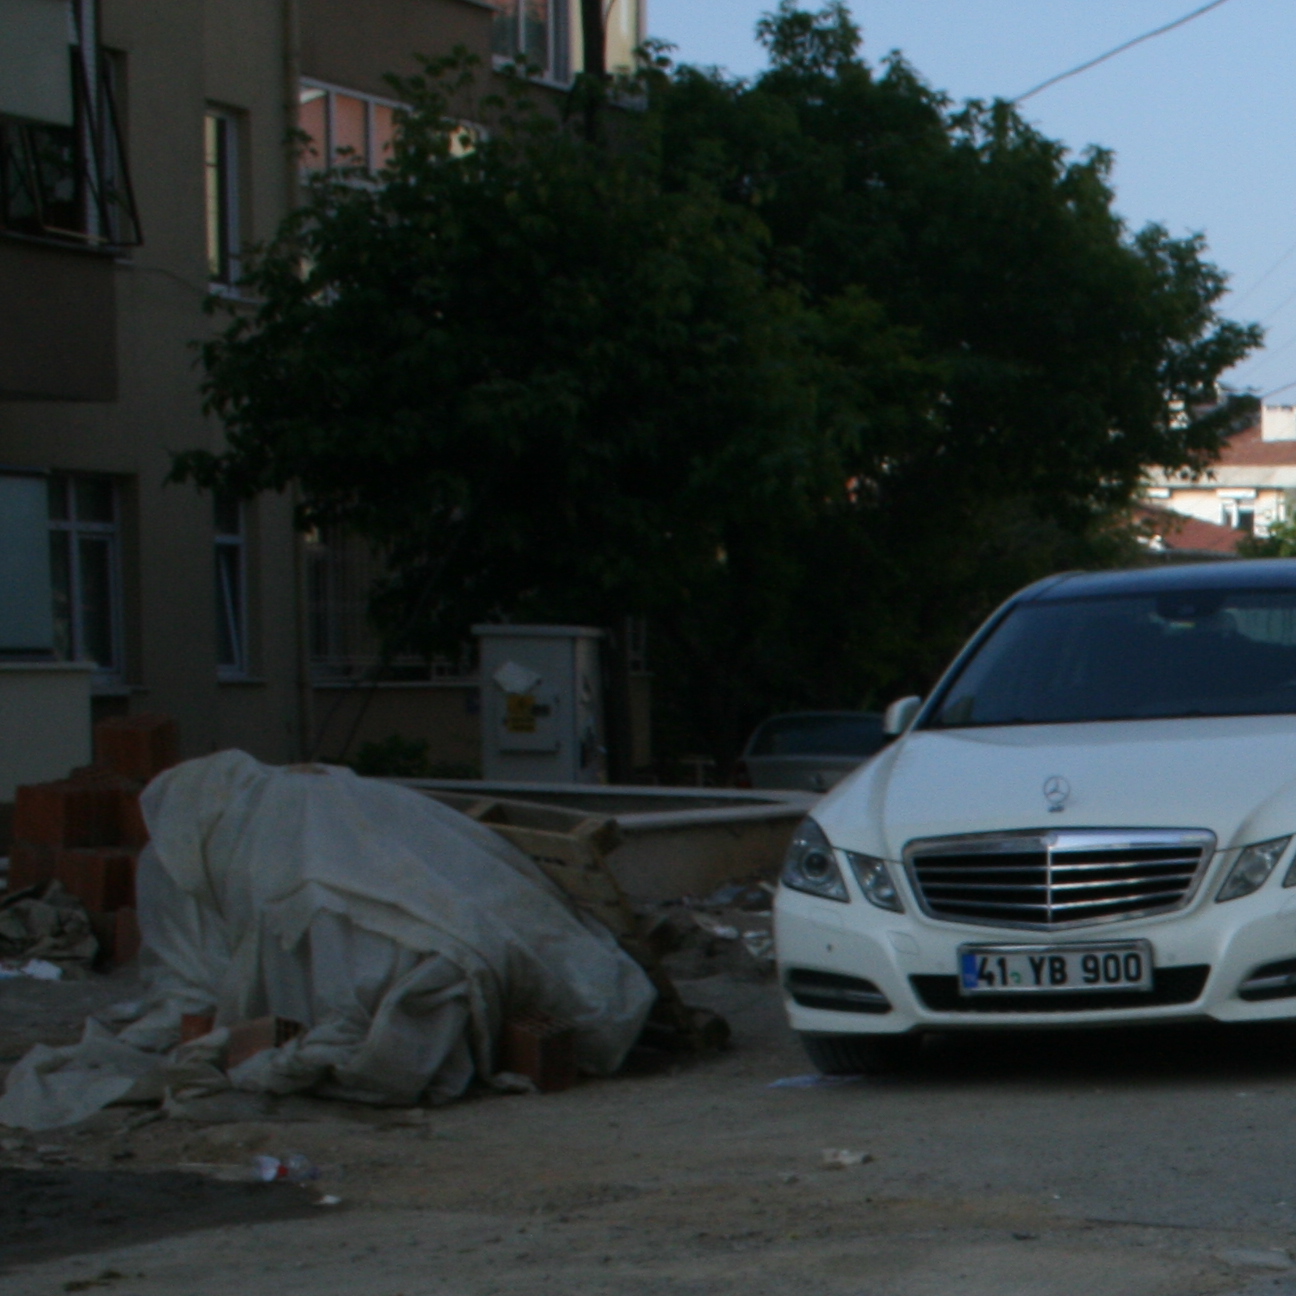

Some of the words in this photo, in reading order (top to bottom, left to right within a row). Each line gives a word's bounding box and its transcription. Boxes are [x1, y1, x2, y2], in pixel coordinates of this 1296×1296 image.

[977, 956, 1009, 986] 41
[1029, 955, 1068, 985] YB
[1081, 953, 1143, 984] 900
